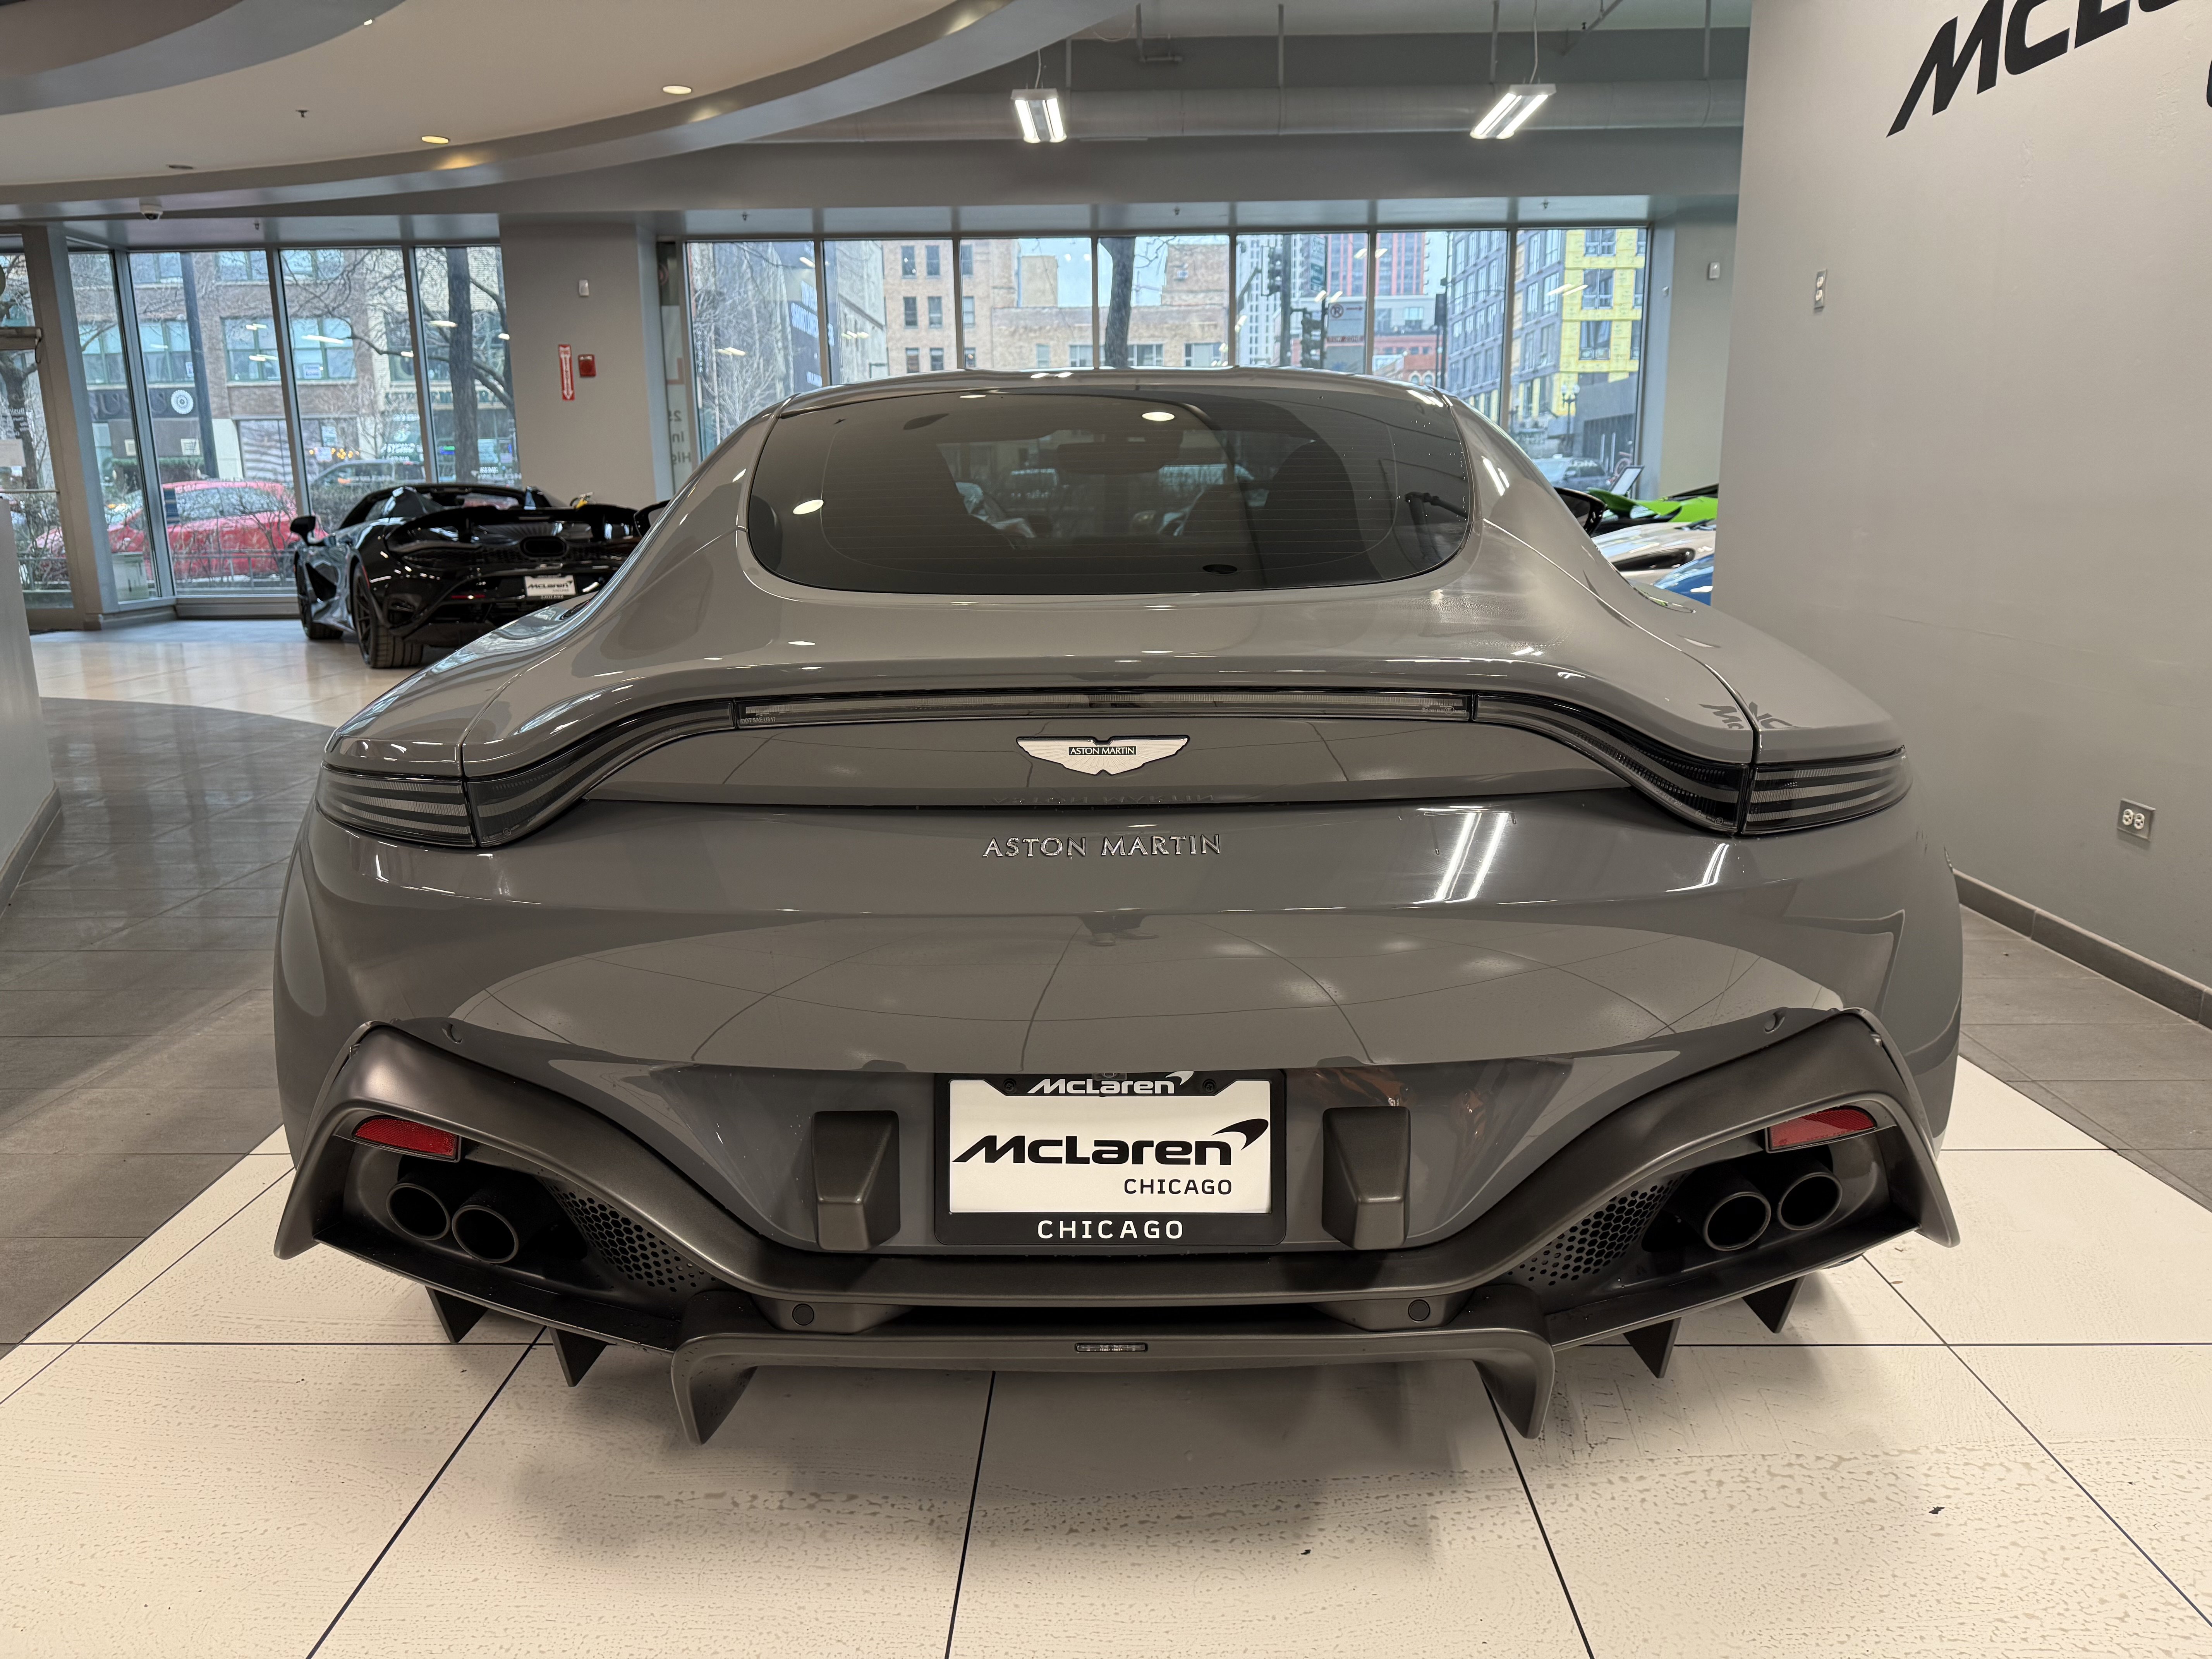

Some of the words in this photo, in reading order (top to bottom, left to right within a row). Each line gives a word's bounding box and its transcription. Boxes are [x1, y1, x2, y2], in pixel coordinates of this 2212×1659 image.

[982, 836, 1086, 857] ASTON
[1101, 834, 1220, 856] MARTIN
[1027, 1078, 1175, 1094] McLaren
[952, 1135, 1232, 1165] McLaren
[1124, 1178, 1232, 1195] CHICAGO
[1037, 1219, 1183, 1239] CHICAGO
